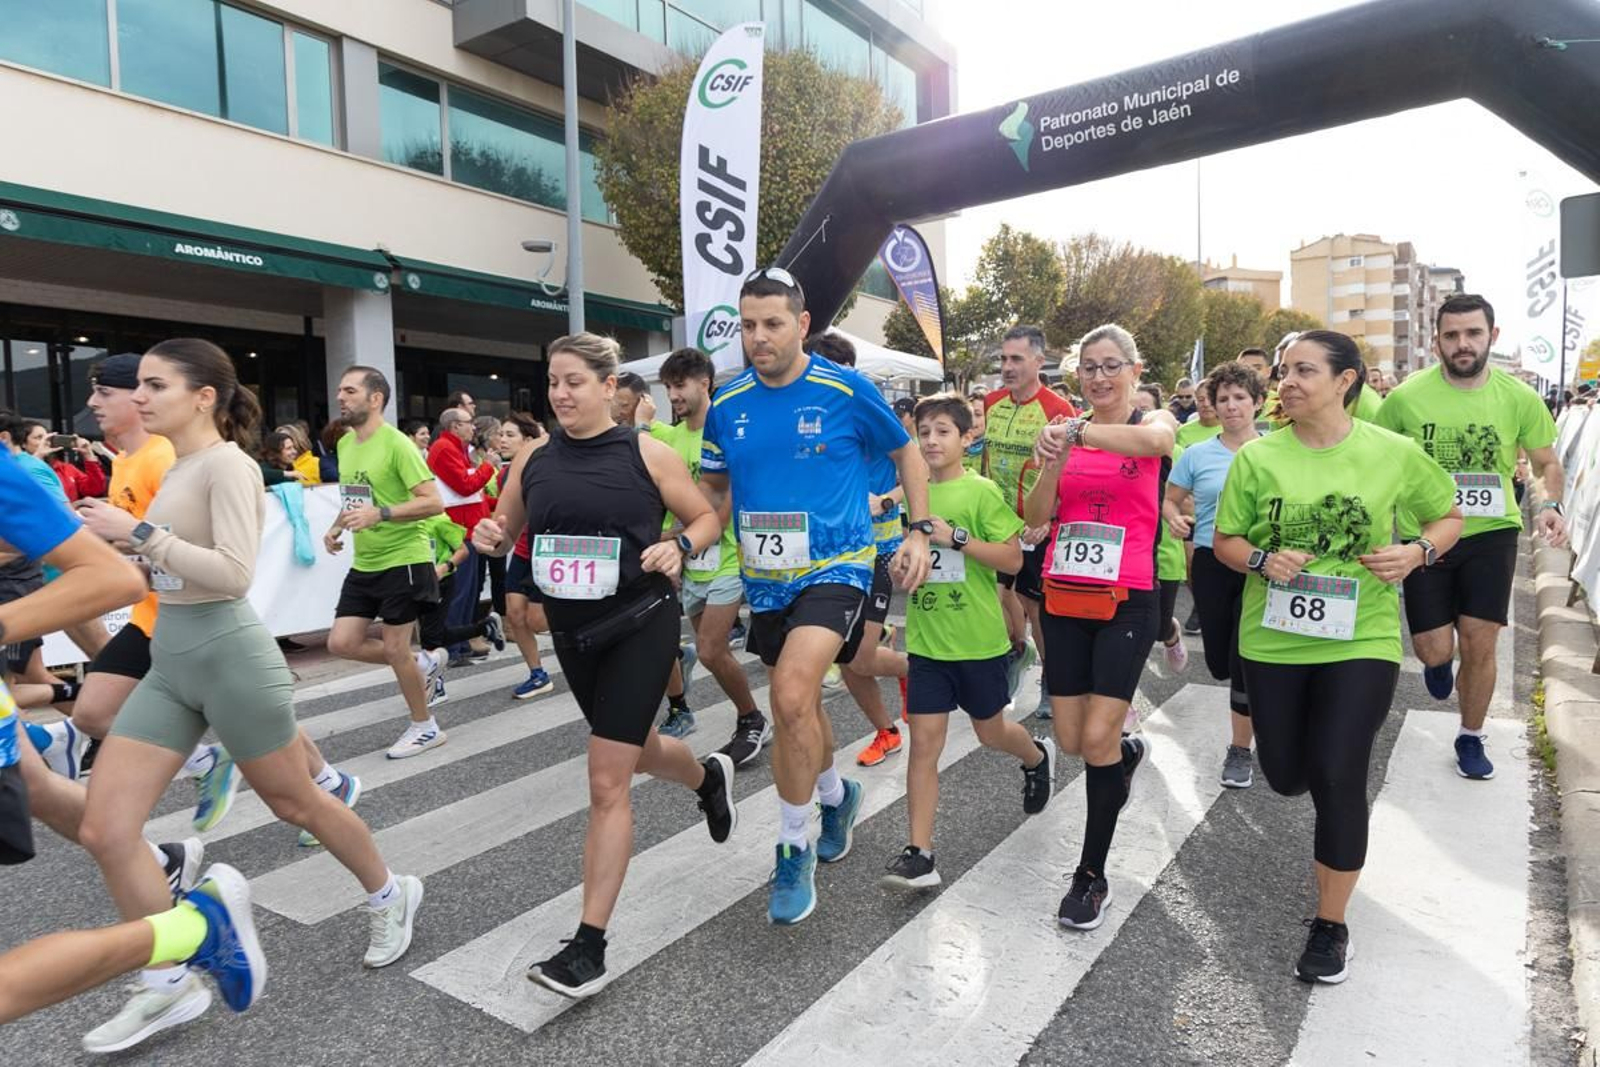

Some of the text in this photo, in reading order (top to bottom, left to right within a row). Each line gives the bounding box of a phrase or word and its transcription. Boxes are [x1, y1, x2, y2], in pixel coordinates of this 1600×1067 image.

[709, 73, 754, 92] CSIF
[1040, 69, 1240, 132] Patronato Municipal de
[1041, 102, 1192, 151] Deportes de Jaén
[694, 143, 747, 276] CSIF
[705, 319, 742, 339] CSIF
[1421, 423, 1436, 441] 17
[755, 533, 784, 556] 73
[1063, 541, 1104, 565] 193
[549, 558, 596, 585] 611
[1290, 595, 1326, 622] 68
